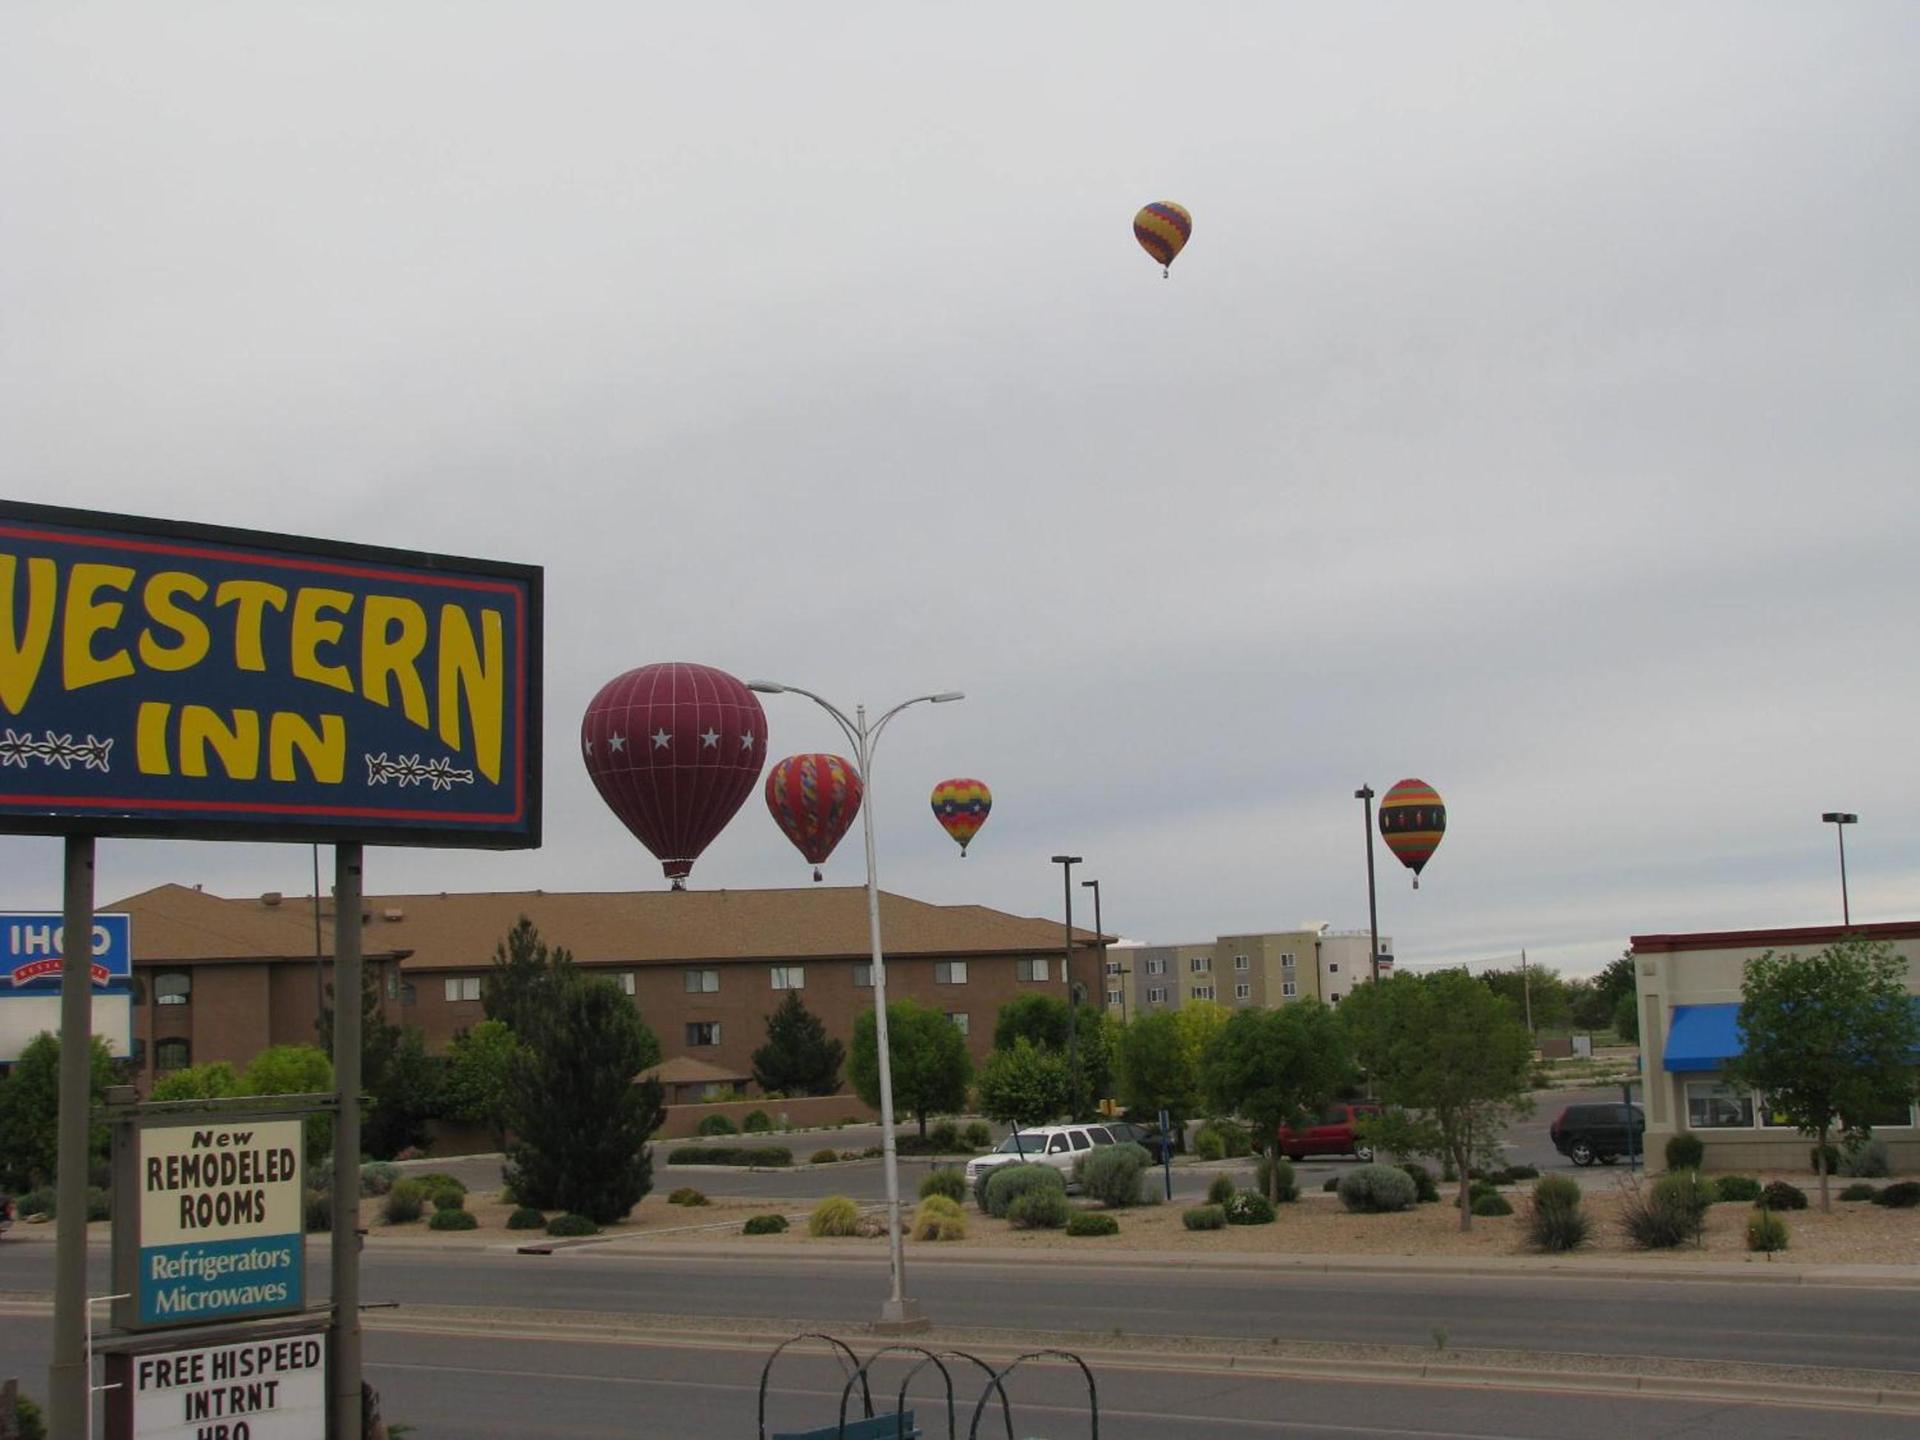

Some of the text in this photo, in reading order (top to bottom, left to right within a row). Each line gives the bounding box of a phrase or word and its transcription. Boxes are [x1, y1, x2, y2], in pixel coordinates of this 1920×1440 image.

[136, 702, 345, 784] INN
[191, 1130, 254, 1149] New
[147, 1148, 295, 1191] REMODELED
[180, 1190, 265, 1229] ROOMS
[151, 1247, 291, 1281] Refrigerators
[155, 1281, 288, 1314] Microwaves
[139, 1340, 320, 1390] FREE HISPEED
[185, 1380, 279, 1421] INTRNT
